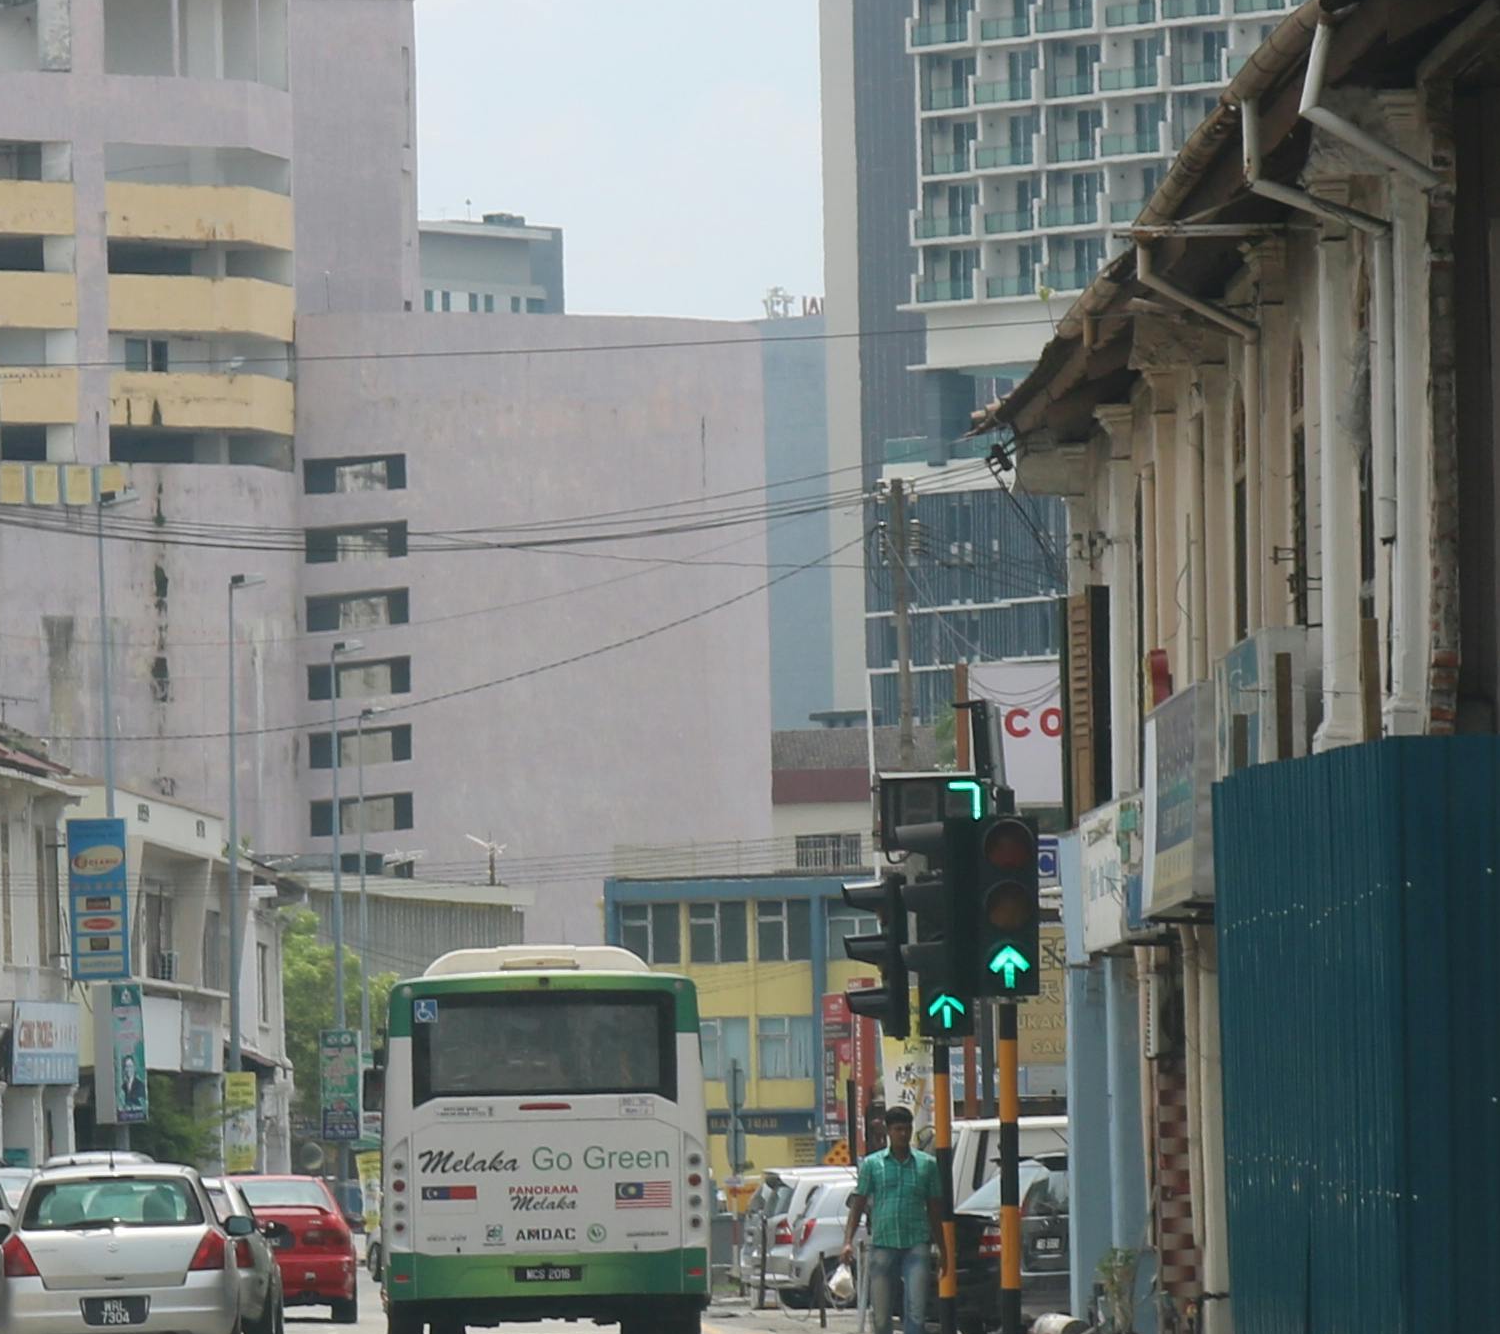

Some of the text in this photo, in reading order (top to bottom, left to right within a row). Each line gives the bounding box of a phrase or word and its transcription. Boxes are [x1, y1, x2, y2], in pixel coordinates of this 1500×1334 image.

[418, 1145, 670, 1174] Melaka Go Green
[508, 1184, 578, 1195] PANORAMA
[510, 1195, 577, 1212] Melaka
[516, 1228, 576, 1242] AMDAC
